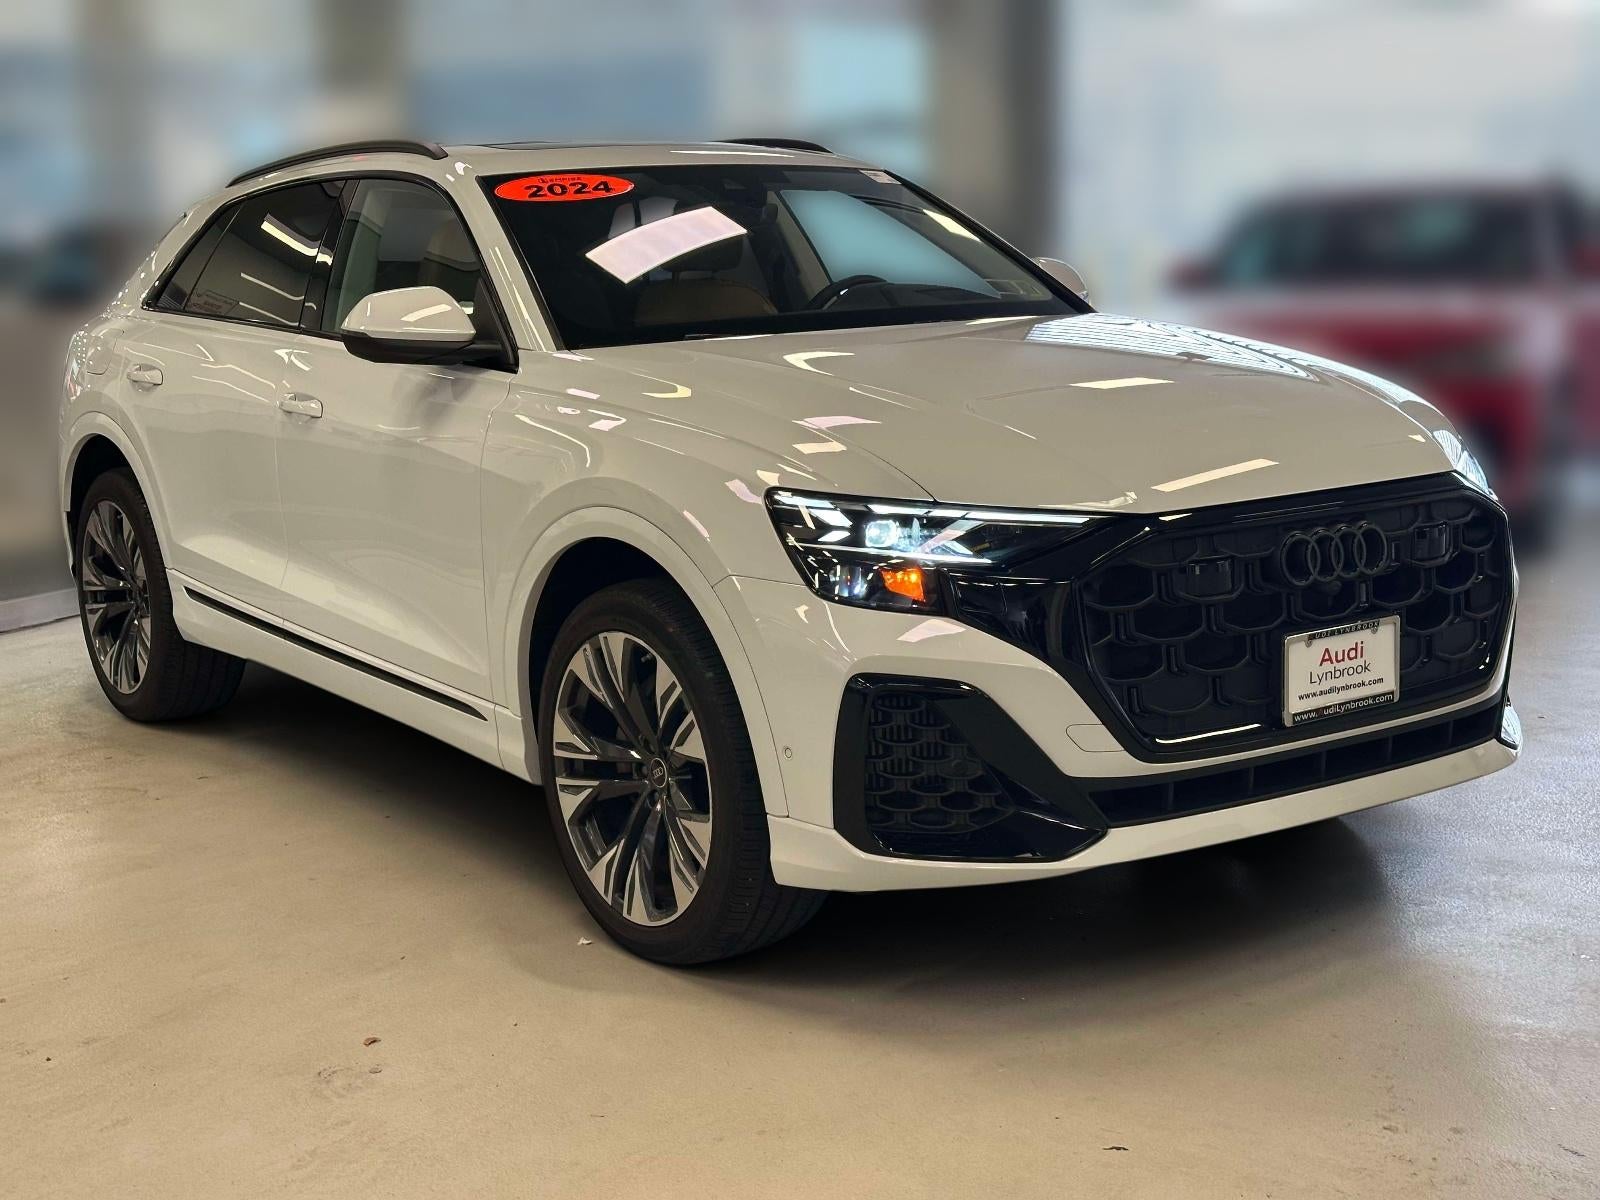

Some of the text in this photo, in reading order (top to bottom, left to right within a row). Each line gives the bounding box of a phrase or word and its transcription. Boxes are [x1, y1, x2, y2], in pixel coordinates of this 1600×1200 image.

[525, 180, 613, 198] 2024
[1319, 641, 1364, 666] Audi
[1309, 660, 1371, 685] Lynbrook
[1298, 677, 1384, 700] www.audilynbrook.com
[1294, 694, 1393, 722] www.udiLynbrook.com
